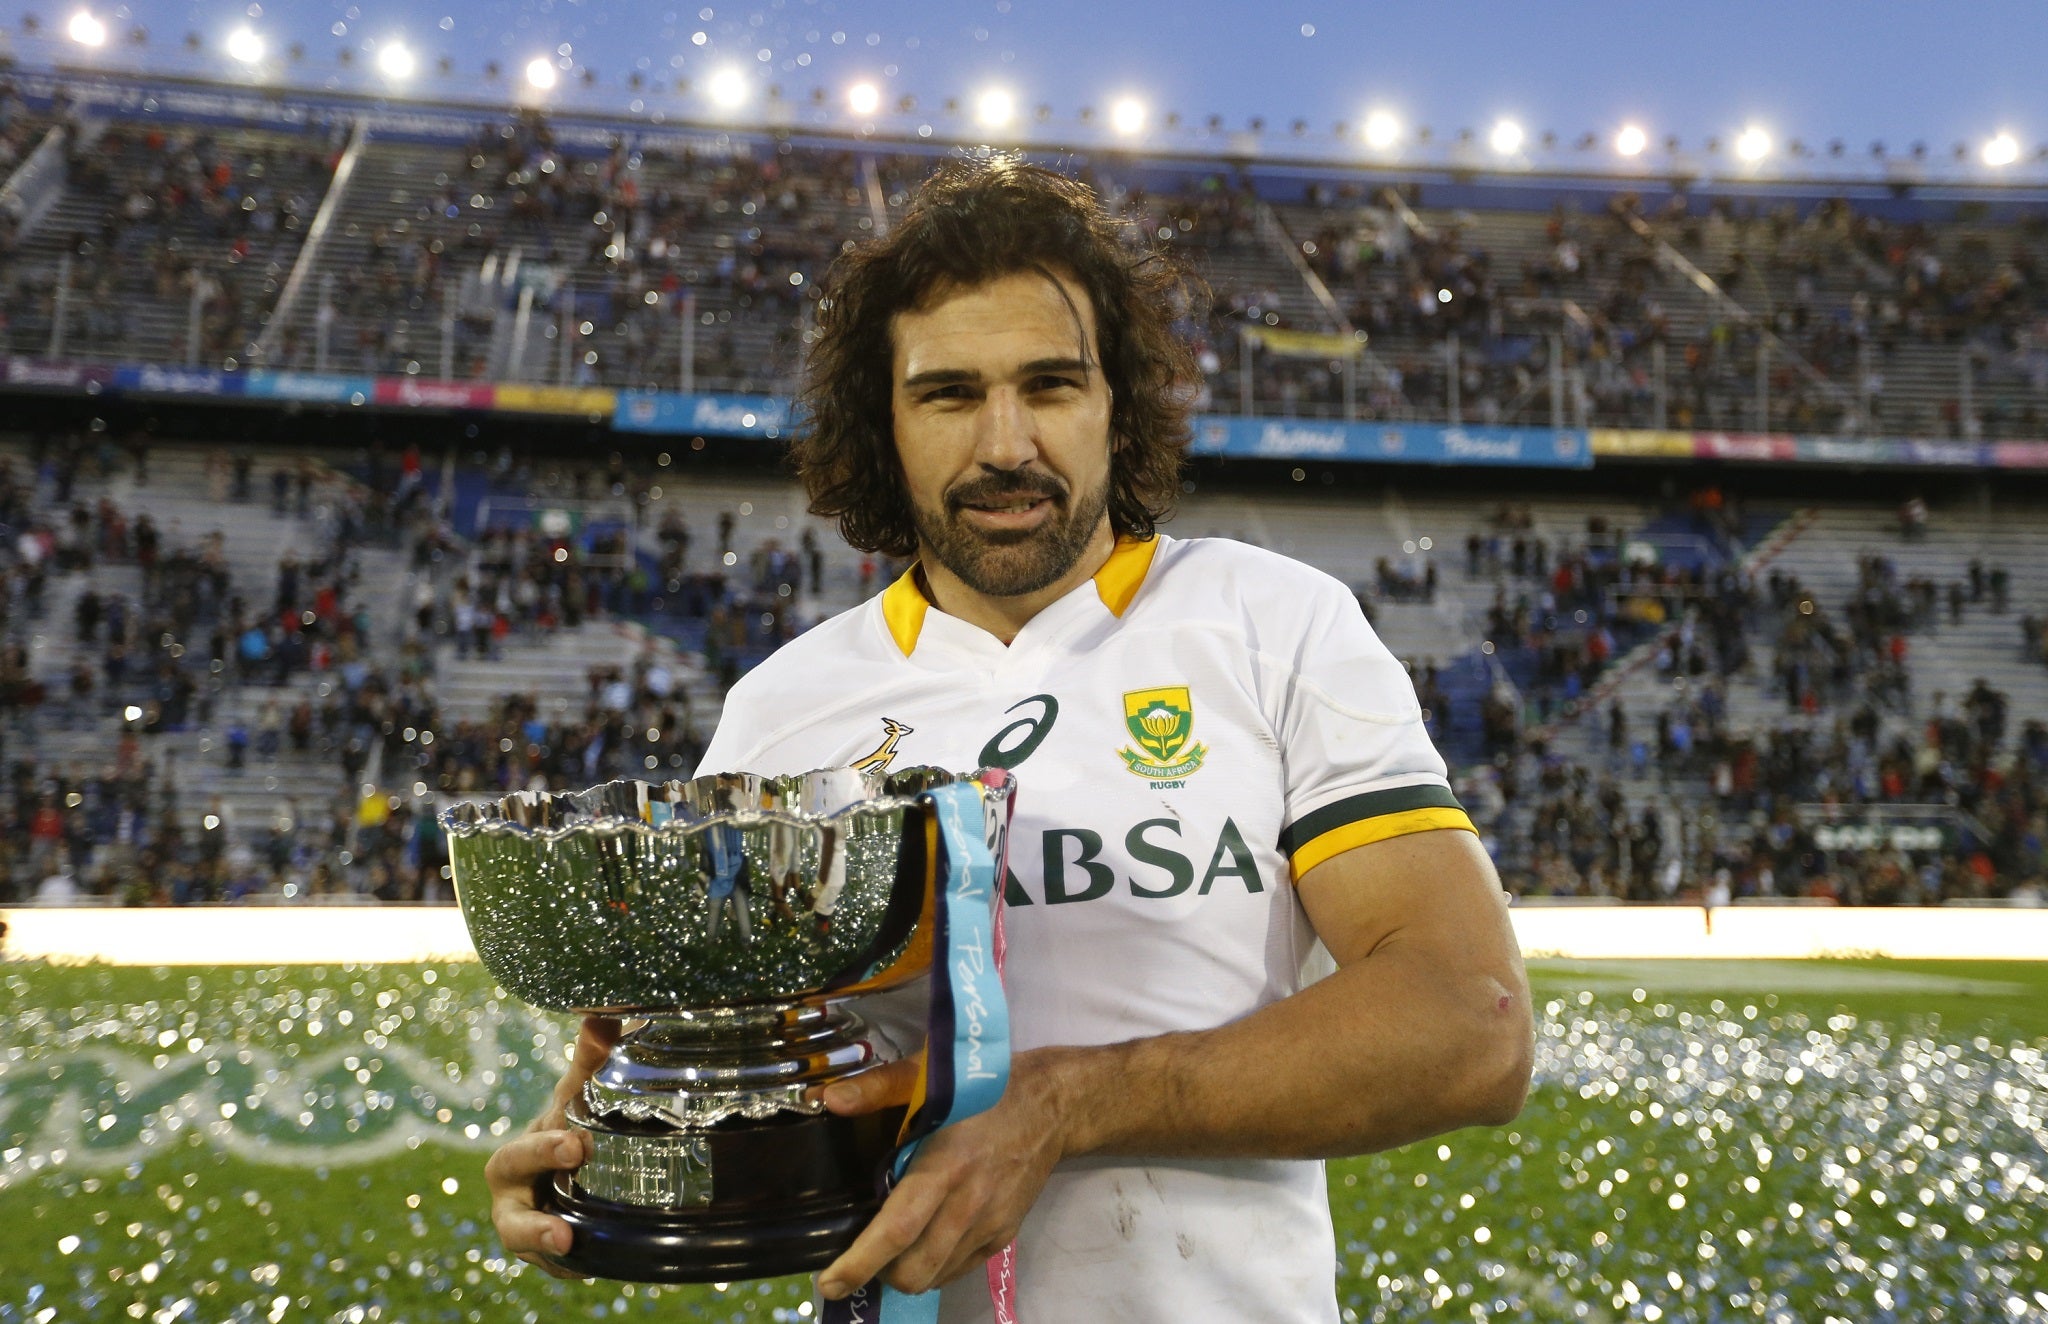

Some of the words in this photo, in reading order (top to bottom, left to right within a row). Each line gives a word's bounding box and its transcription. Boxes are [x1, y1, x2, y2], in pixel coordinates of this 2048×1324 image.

[1134, 763, 1164, 776] SOUTH
[1166, 760, 1198, 776] AFRICA
[1149, 781, 1186, 790] RUGBY
[957, 927, 998, 1081] Personal
